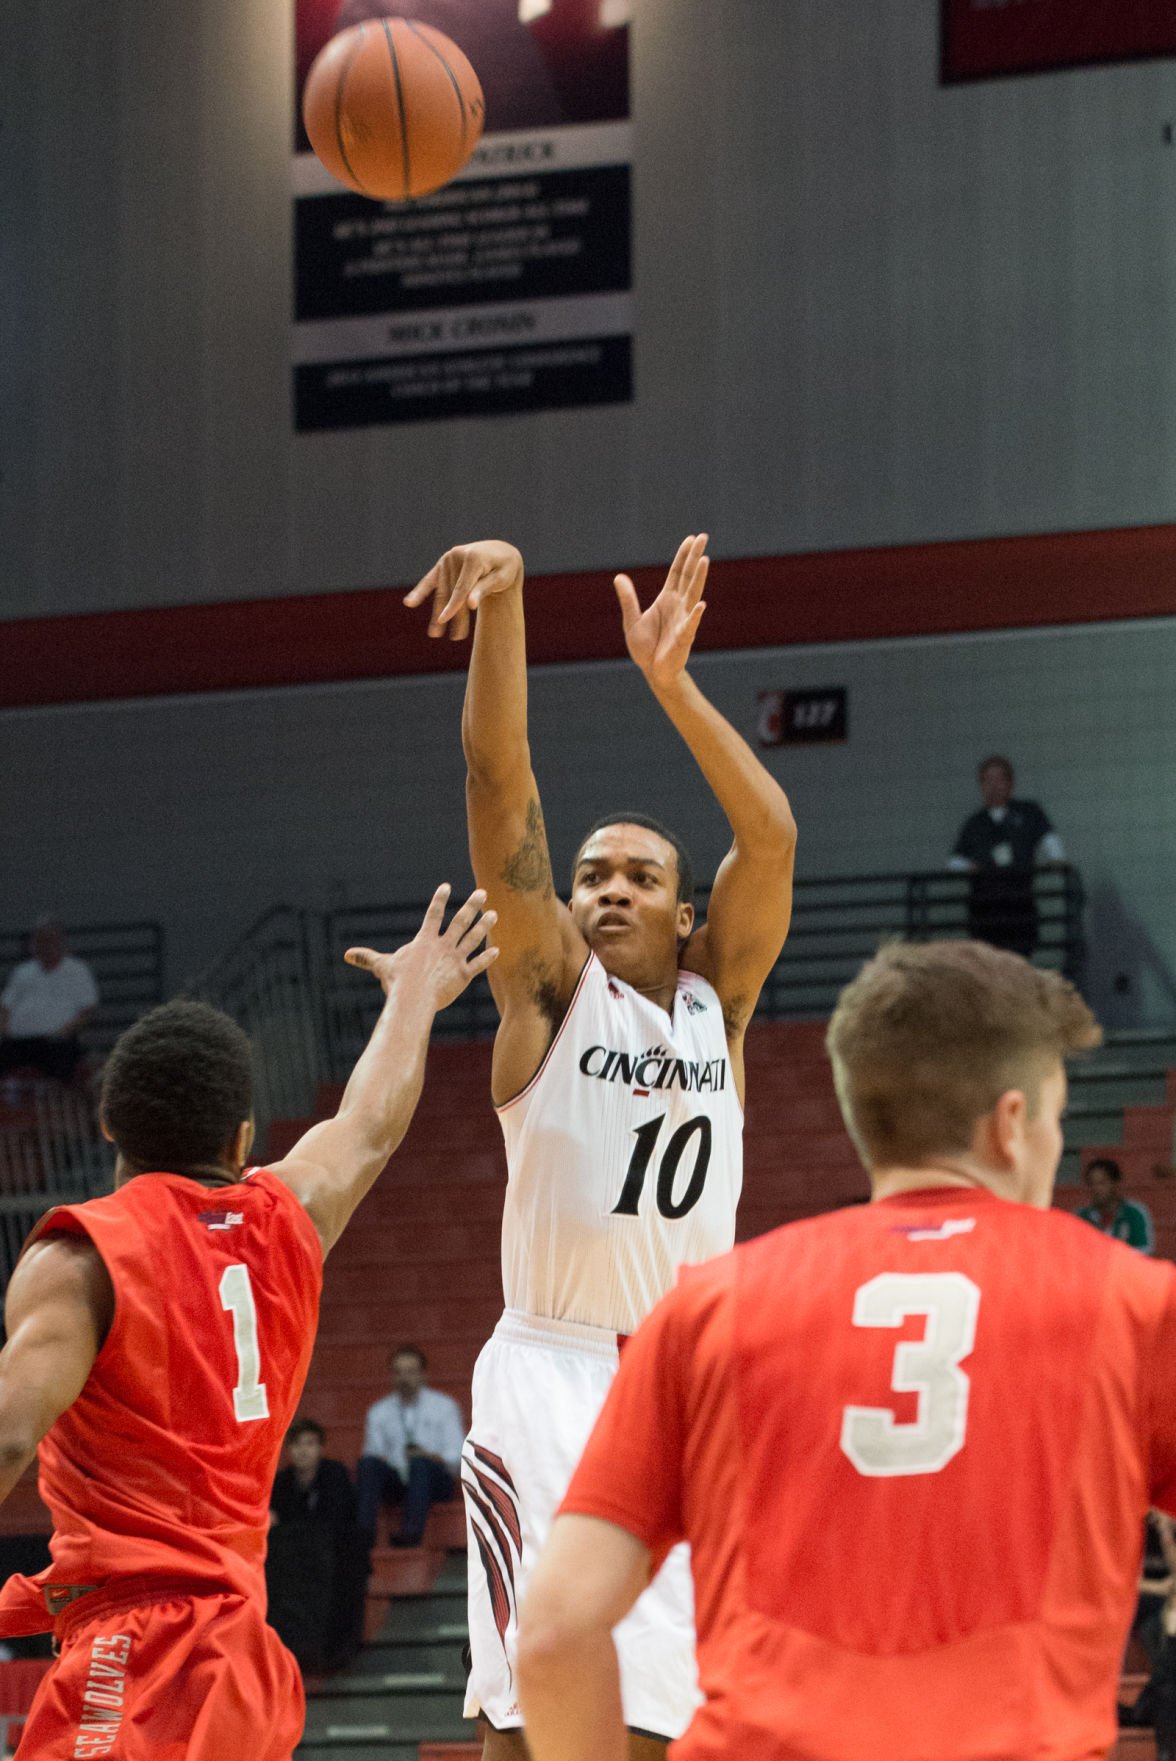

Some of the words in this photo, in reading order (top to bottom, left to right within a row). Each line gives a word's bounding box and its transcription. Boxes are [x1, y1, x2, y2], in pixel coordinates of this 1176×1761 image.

[579, 1045, 726, 1093] CINCINNATI
[610, 1112, 712, 1220] 10
[218, 1263, 270, 1423] 1
[839, 1272, 982, 1477] 3
[74, 1634, 132, 1759] SEAWOLVES
